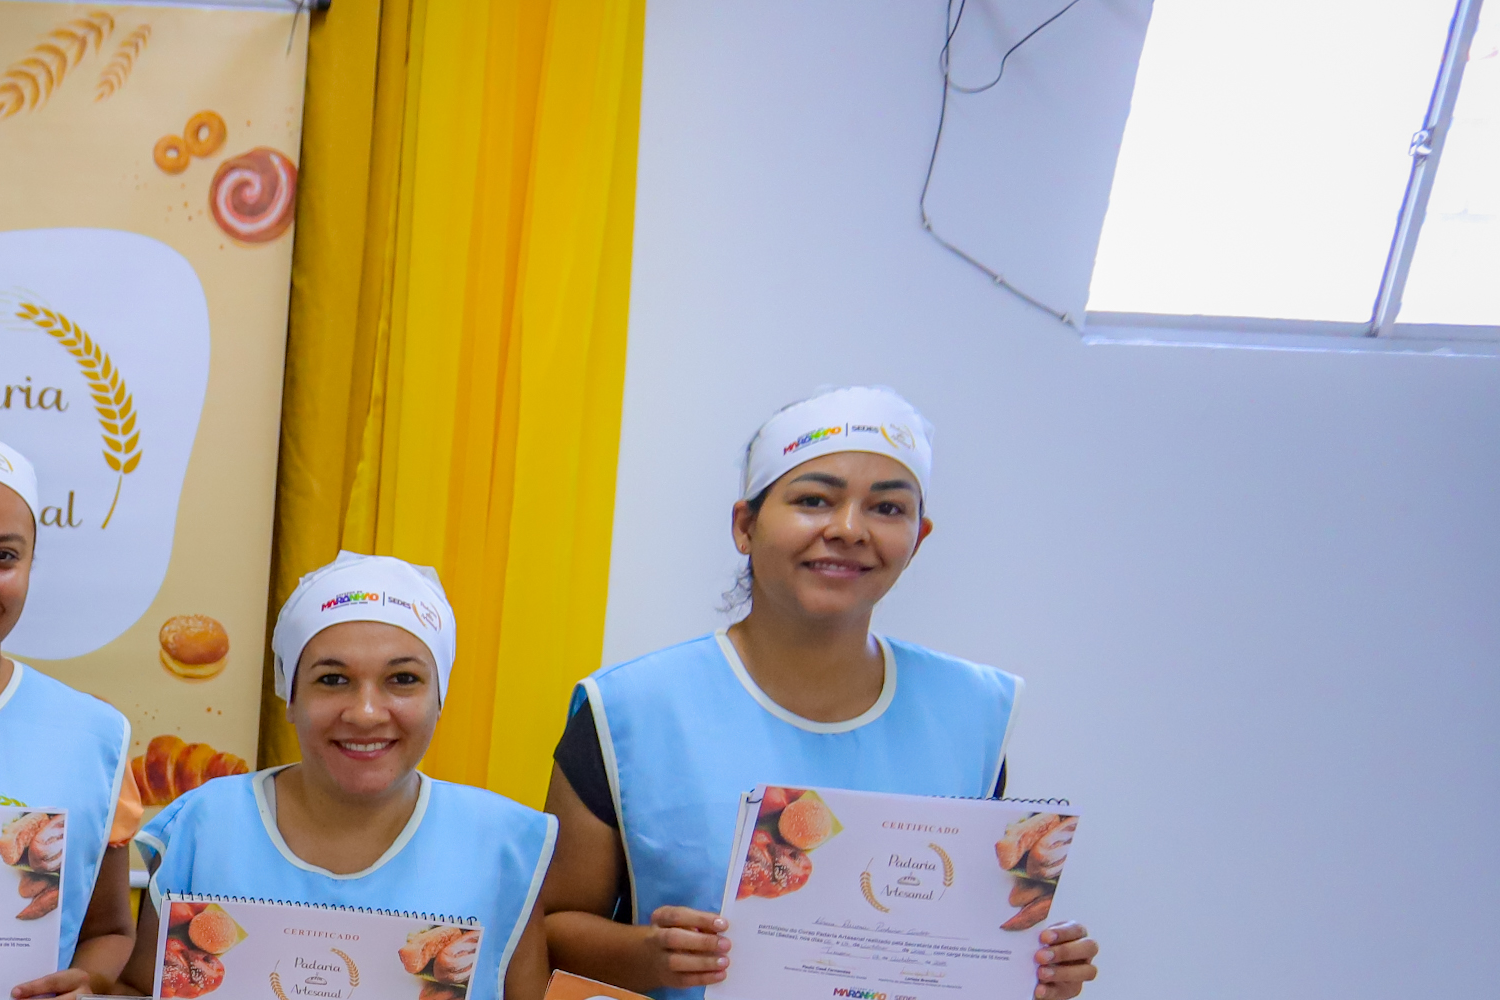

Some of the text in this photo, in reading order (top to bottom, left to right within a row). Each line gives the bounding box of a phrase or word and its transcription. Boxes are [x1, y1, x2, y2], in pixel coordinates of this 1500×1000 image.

[388, 596, 411, 610] SEDES
[881, 821, 959, 835] CERTIFICADO
[888, 854, 936, 871] Padaria
[880, 885, 934, 901] Artesanal
[283, 927, 360, 941] CERTIFICADO
[294, 957, 342, 973] Padaria
[291, 984, 343, 999] Artesanal
